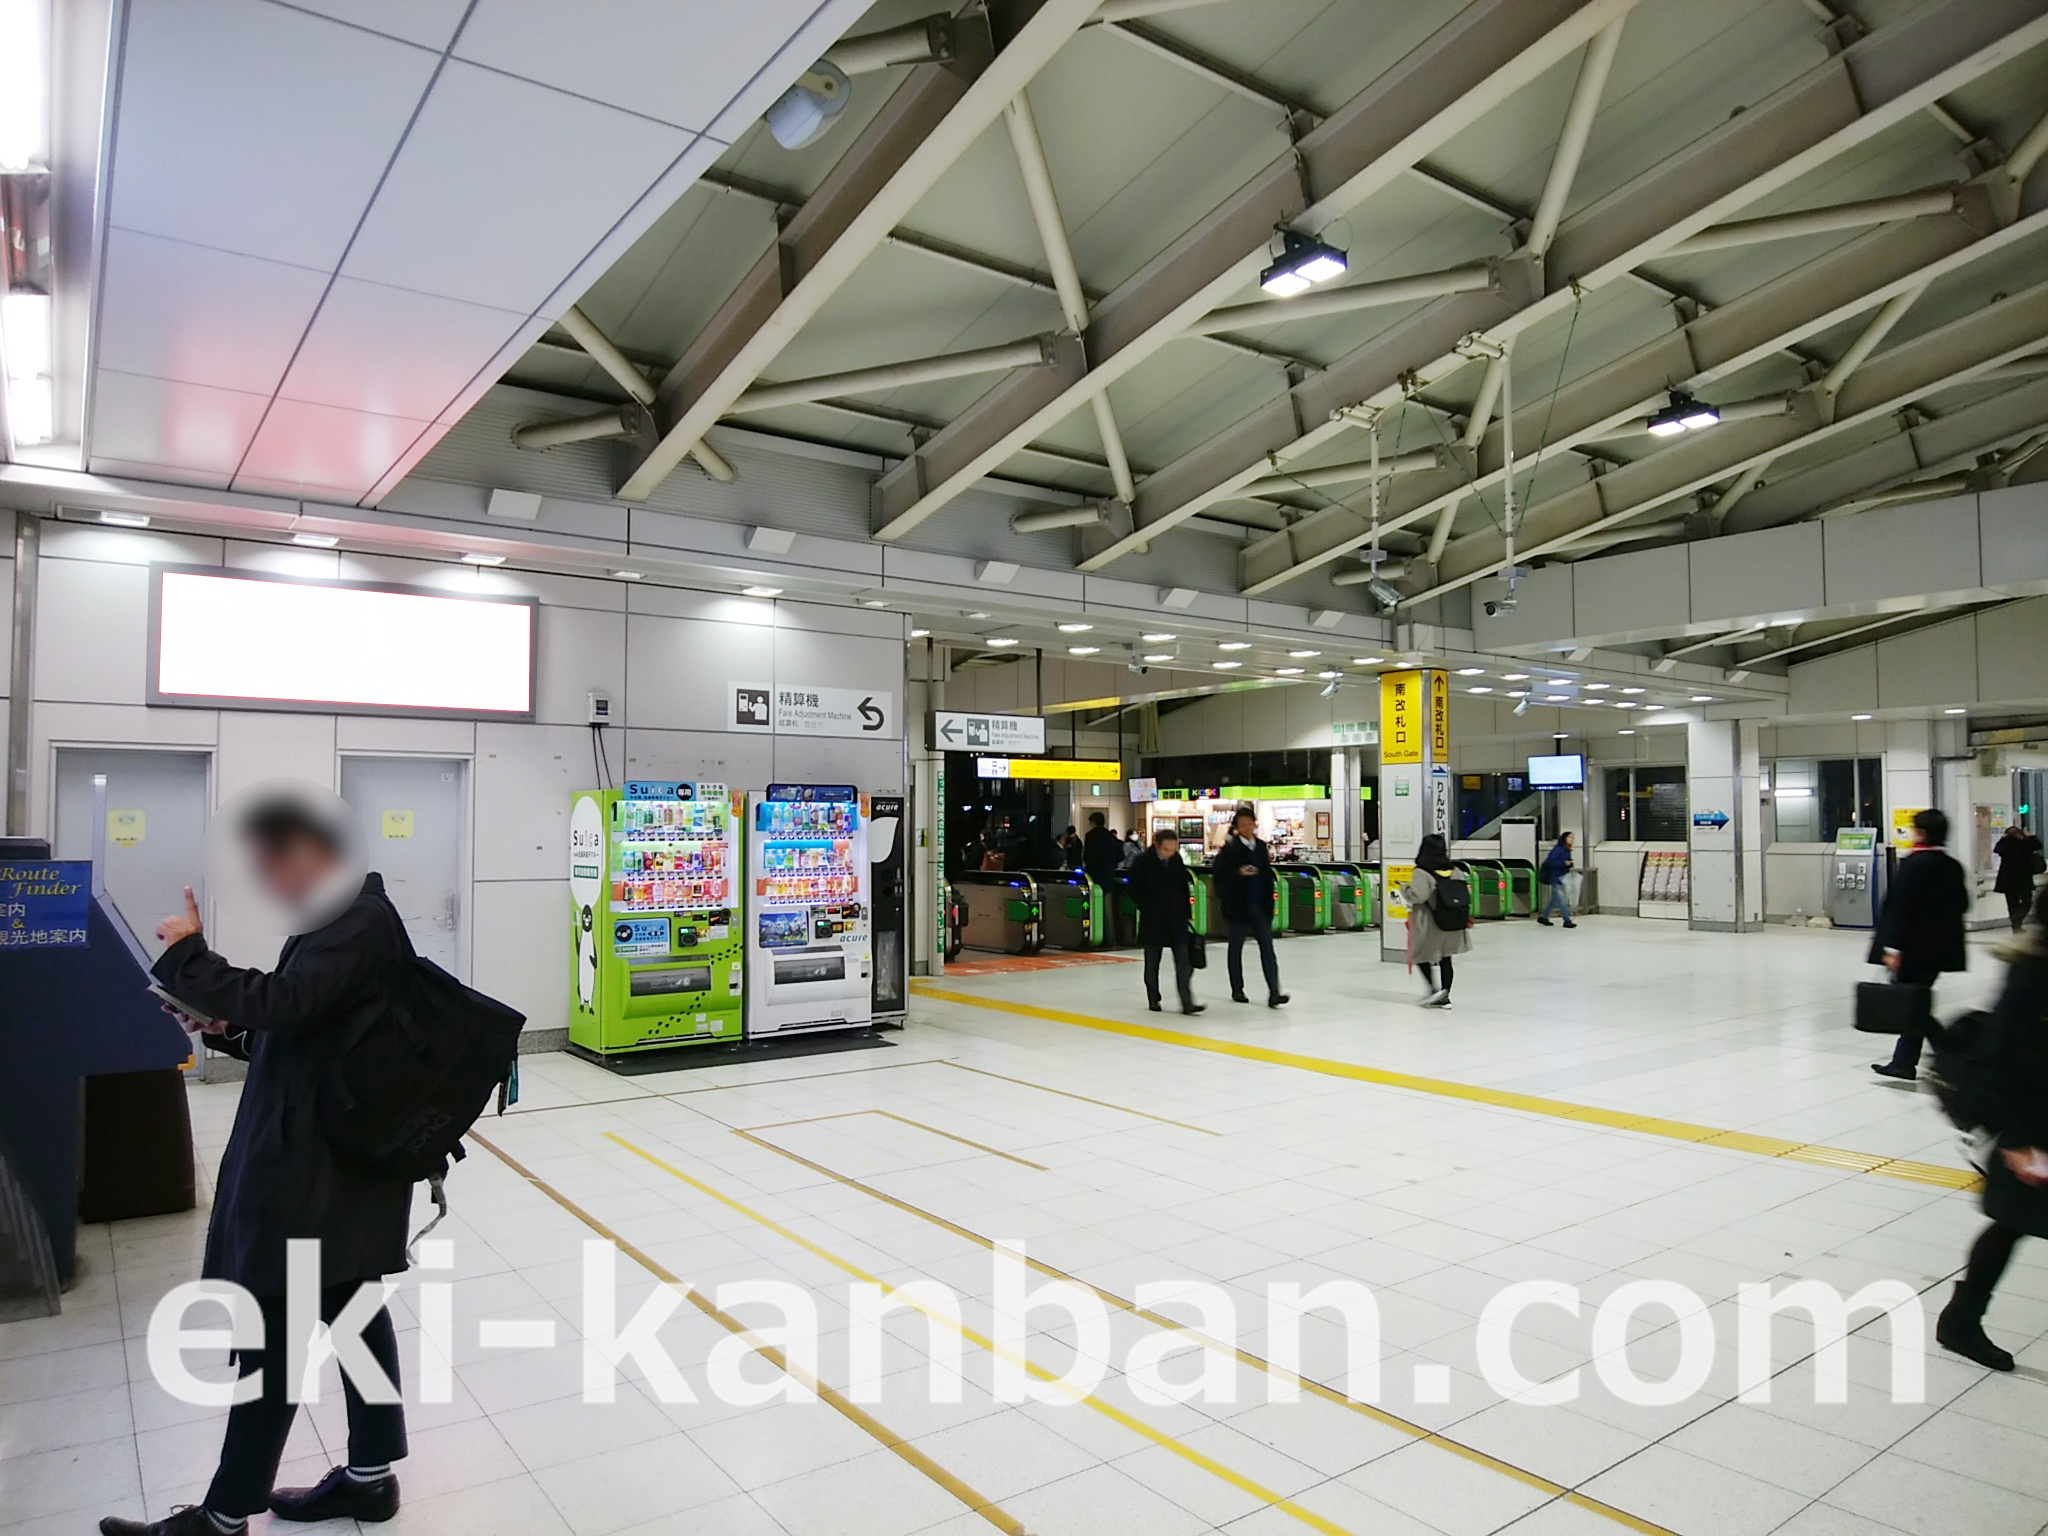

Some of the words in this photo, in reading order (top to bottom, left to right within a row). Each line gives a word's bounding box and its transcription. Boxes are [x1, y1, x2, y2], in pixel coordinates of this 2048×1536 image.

[778, 691, 819, 707] 精算機
[778, 709, 793, 717] Fare
[794, 710, 827, 719] Adjustment
[828, 711, 852, 720] Machine
[1395, 683, 1406, 743] 南改札口
[991, 719, 1018, 731] 精算機
[1435, 696, 1444, 748] 南改札口
[629, 783, 674, 795] Suica
[1192, 788, 1217, 797] KIOSK
[875, 803, 899, 811] acure
[573, 830, 599, 846] Suica
[0, 867, 60, 880] Route
[9, 879, 82, 899] Finder
[12, 918, 26, 929] &
[634, 924, 665, 932] Suica
[839, 934, 868, 943] acure
